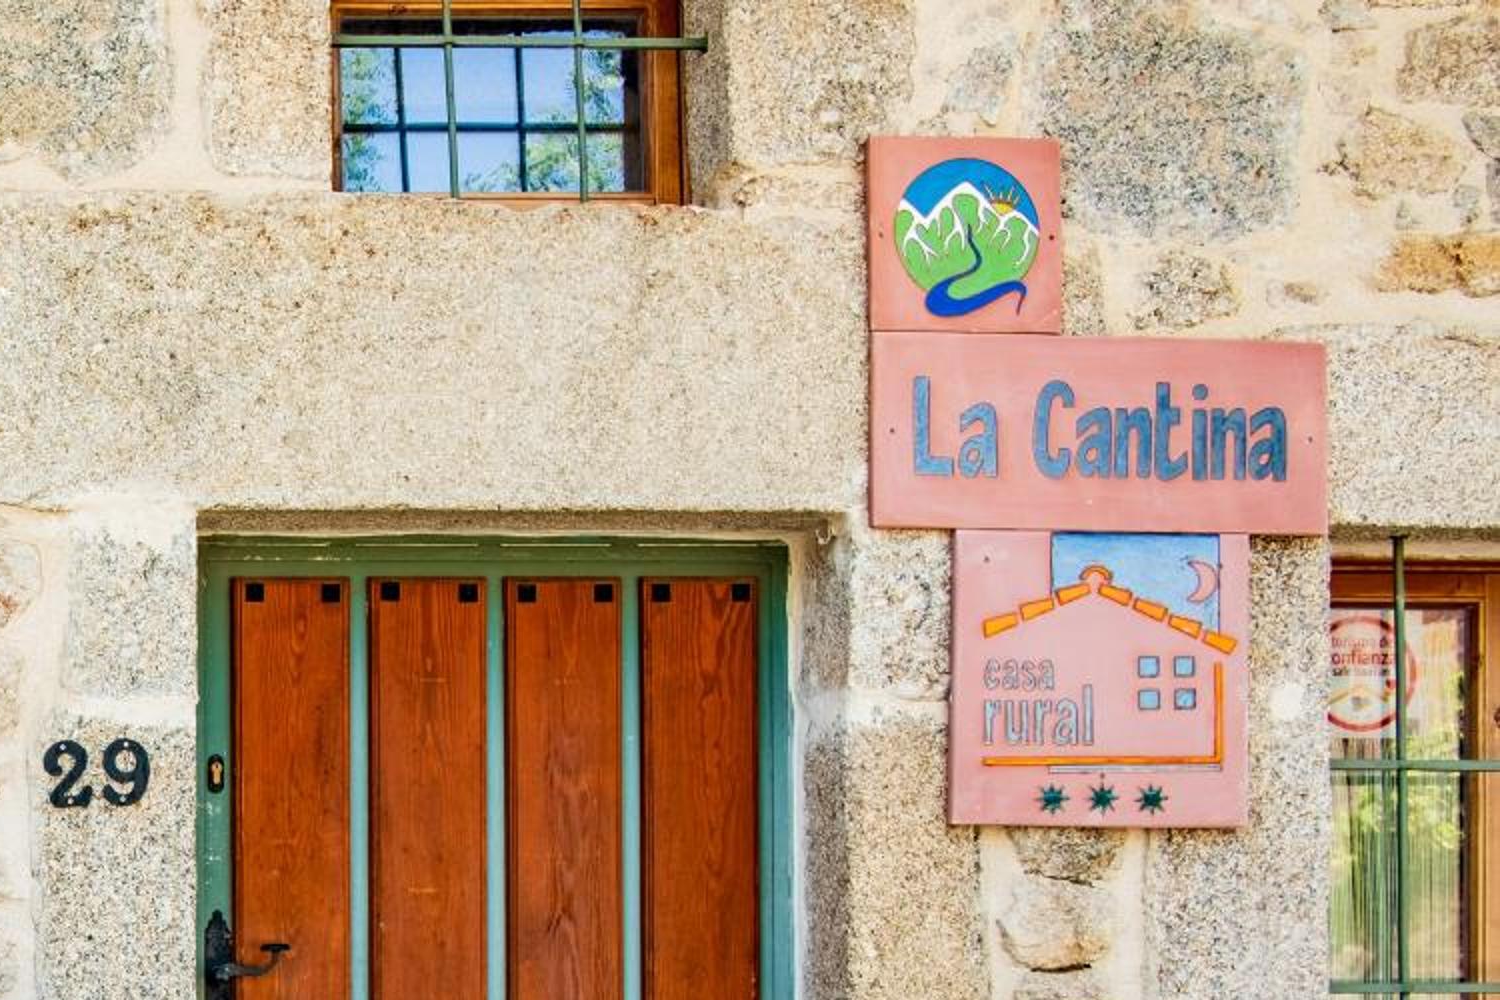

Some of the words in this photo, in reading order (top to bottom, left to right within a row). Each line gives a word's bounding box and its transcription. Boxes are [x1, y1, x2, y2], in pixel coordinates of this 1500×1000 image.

[912, 375, 999, 479] La
[1031, 378, 1288, 482] Cantina
[982, 656, 1056, 690] casa
[982, 683, 1094, 746] rural
[43, 737, 151, 809] 29
